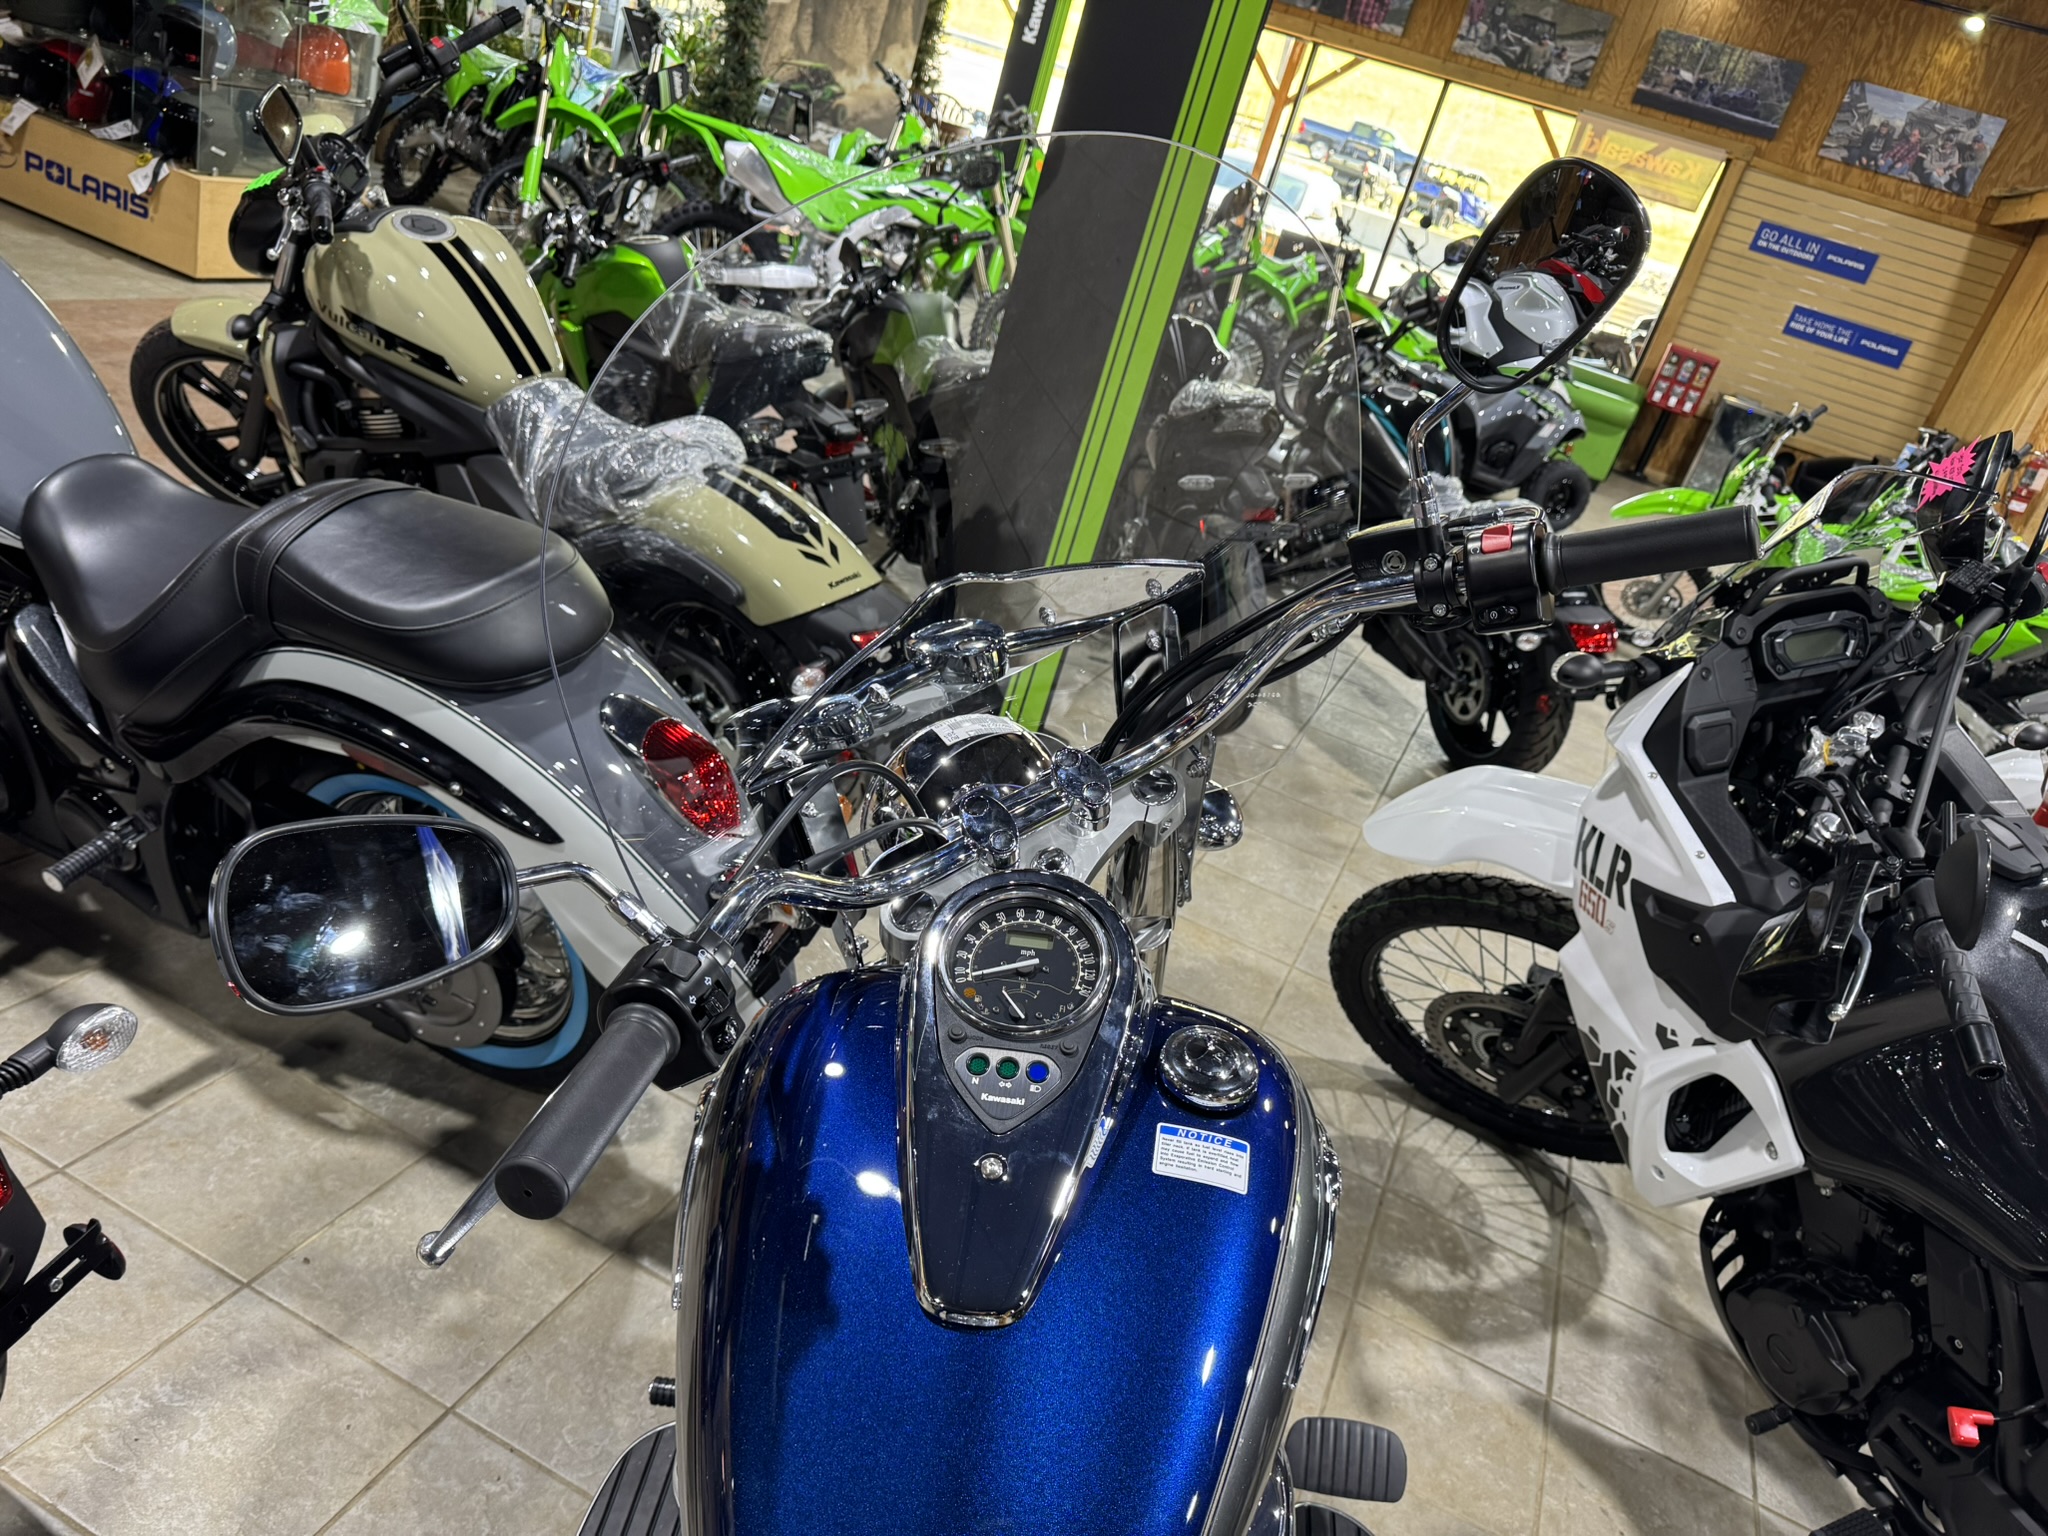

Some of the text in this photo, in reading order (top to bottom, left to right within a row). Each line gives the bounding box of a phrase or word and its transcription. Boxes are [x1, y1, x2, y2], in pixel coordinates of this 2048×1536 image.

[24, 150, 149, 219] POLARIS
[1760, 228, 1821, 255] GO ALL IN
[1826, 253, 1866, 271] POLARIS
[1805, 326, 1815, 335] OF
[1860, 338, 1899, 356] POLARIS
[1574, 816, 1632, 911] KLR
[1579, 879, 1607, 928] 650
[995, 912, 1007, 923] 50
[1016, 908, 1025, 918] 60
[1035, 909, 1045, 920] 70
[979, 920, 990, 931] 40
[1051, 916, 1063, 927] 80
[1065, 925, 1078, 937] 90
[964, 933, 977, 944] 30
[1076, 937, 1090, 950] 100
[956, 950, 968, 959] 20
[1020, 949, 1036, 957] mph
[1082, 952, 1095, 965] 110
[955, 966, 966, 976] 10
[1084, 968, 1096, 981] 120
[972, 1077, 979, 1085] N
[981, 1093, 1025, 1106] Kawasaki
[1177, 1129, 1233, 1148] NOTICE
